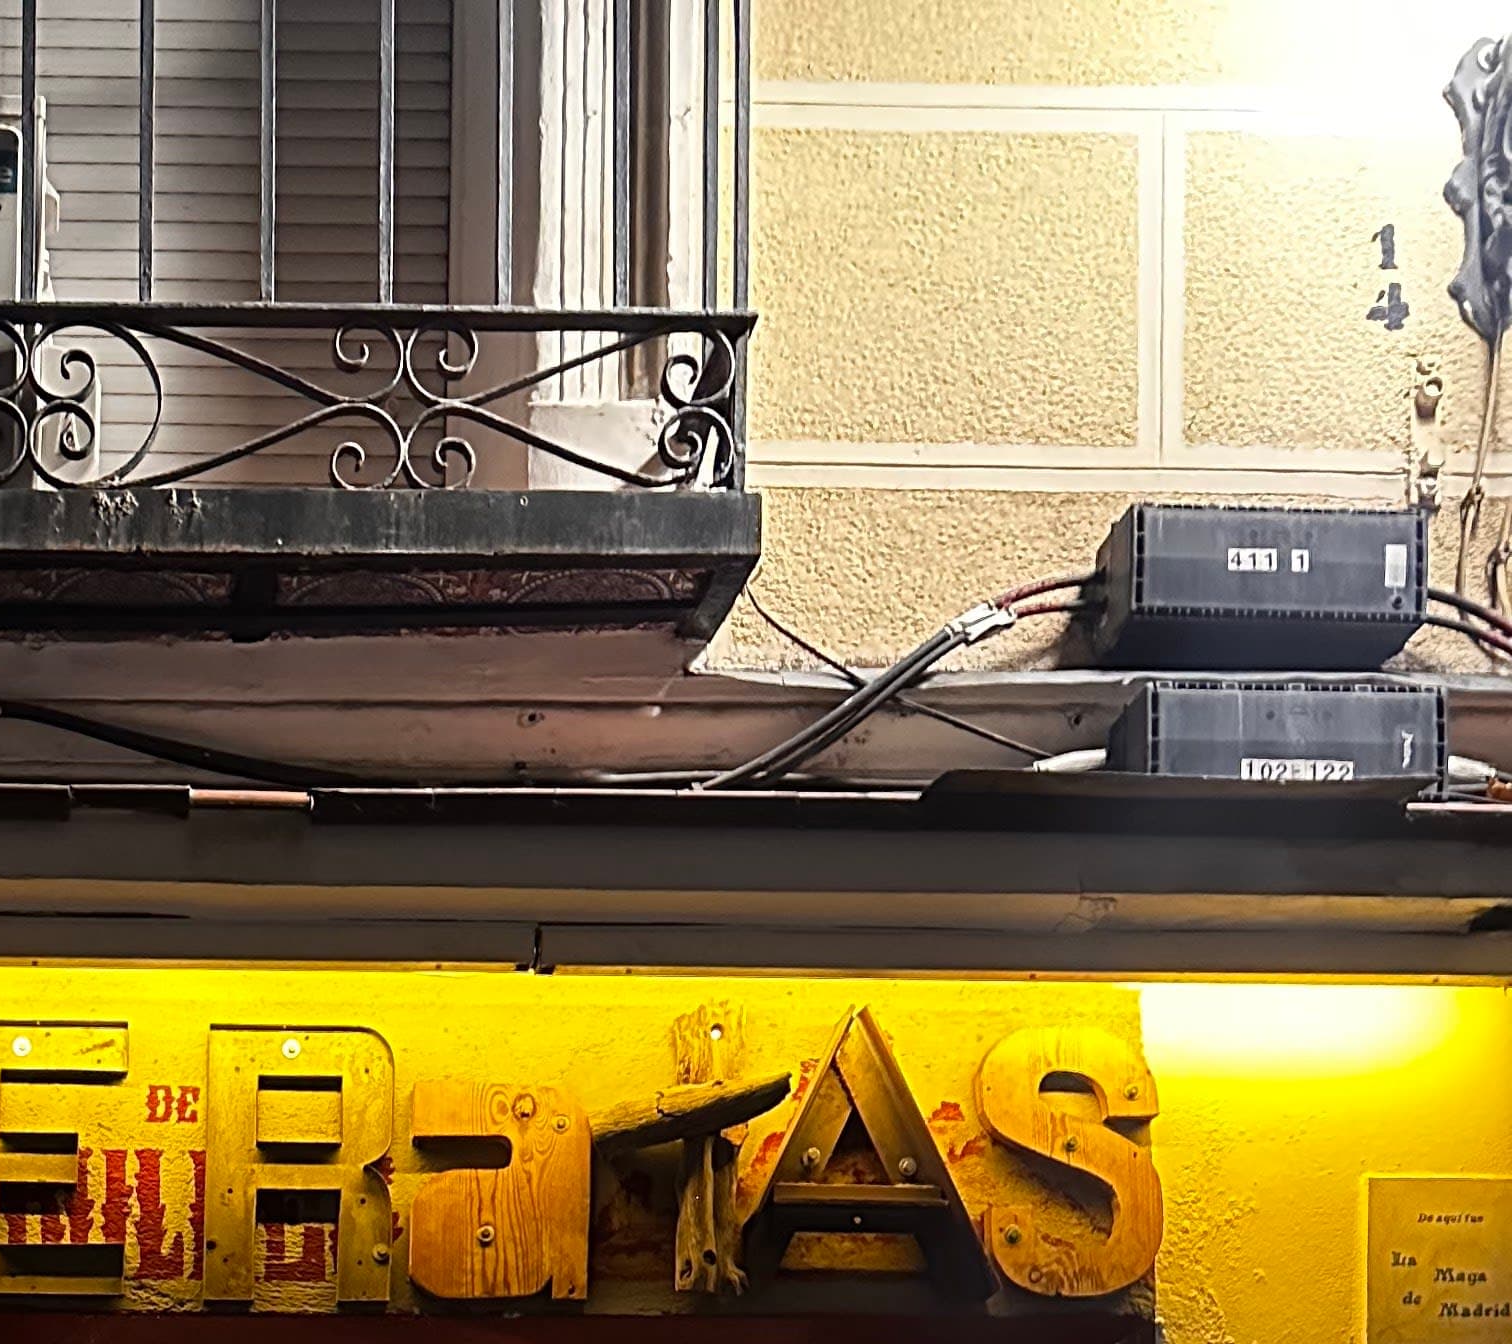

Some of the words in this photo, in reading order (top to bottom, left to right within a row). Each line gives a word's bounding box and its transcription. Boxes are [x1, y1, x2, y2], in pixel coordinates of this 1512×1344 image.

[1229, 549, 1278, 572] 411
[145, 1085, 201, 1123] DE
[1391, 1250, 1417, 1267] La
[1402, 1290, 1422, 1305] de
[1438, 1302, 1511, 1318] Madrid
